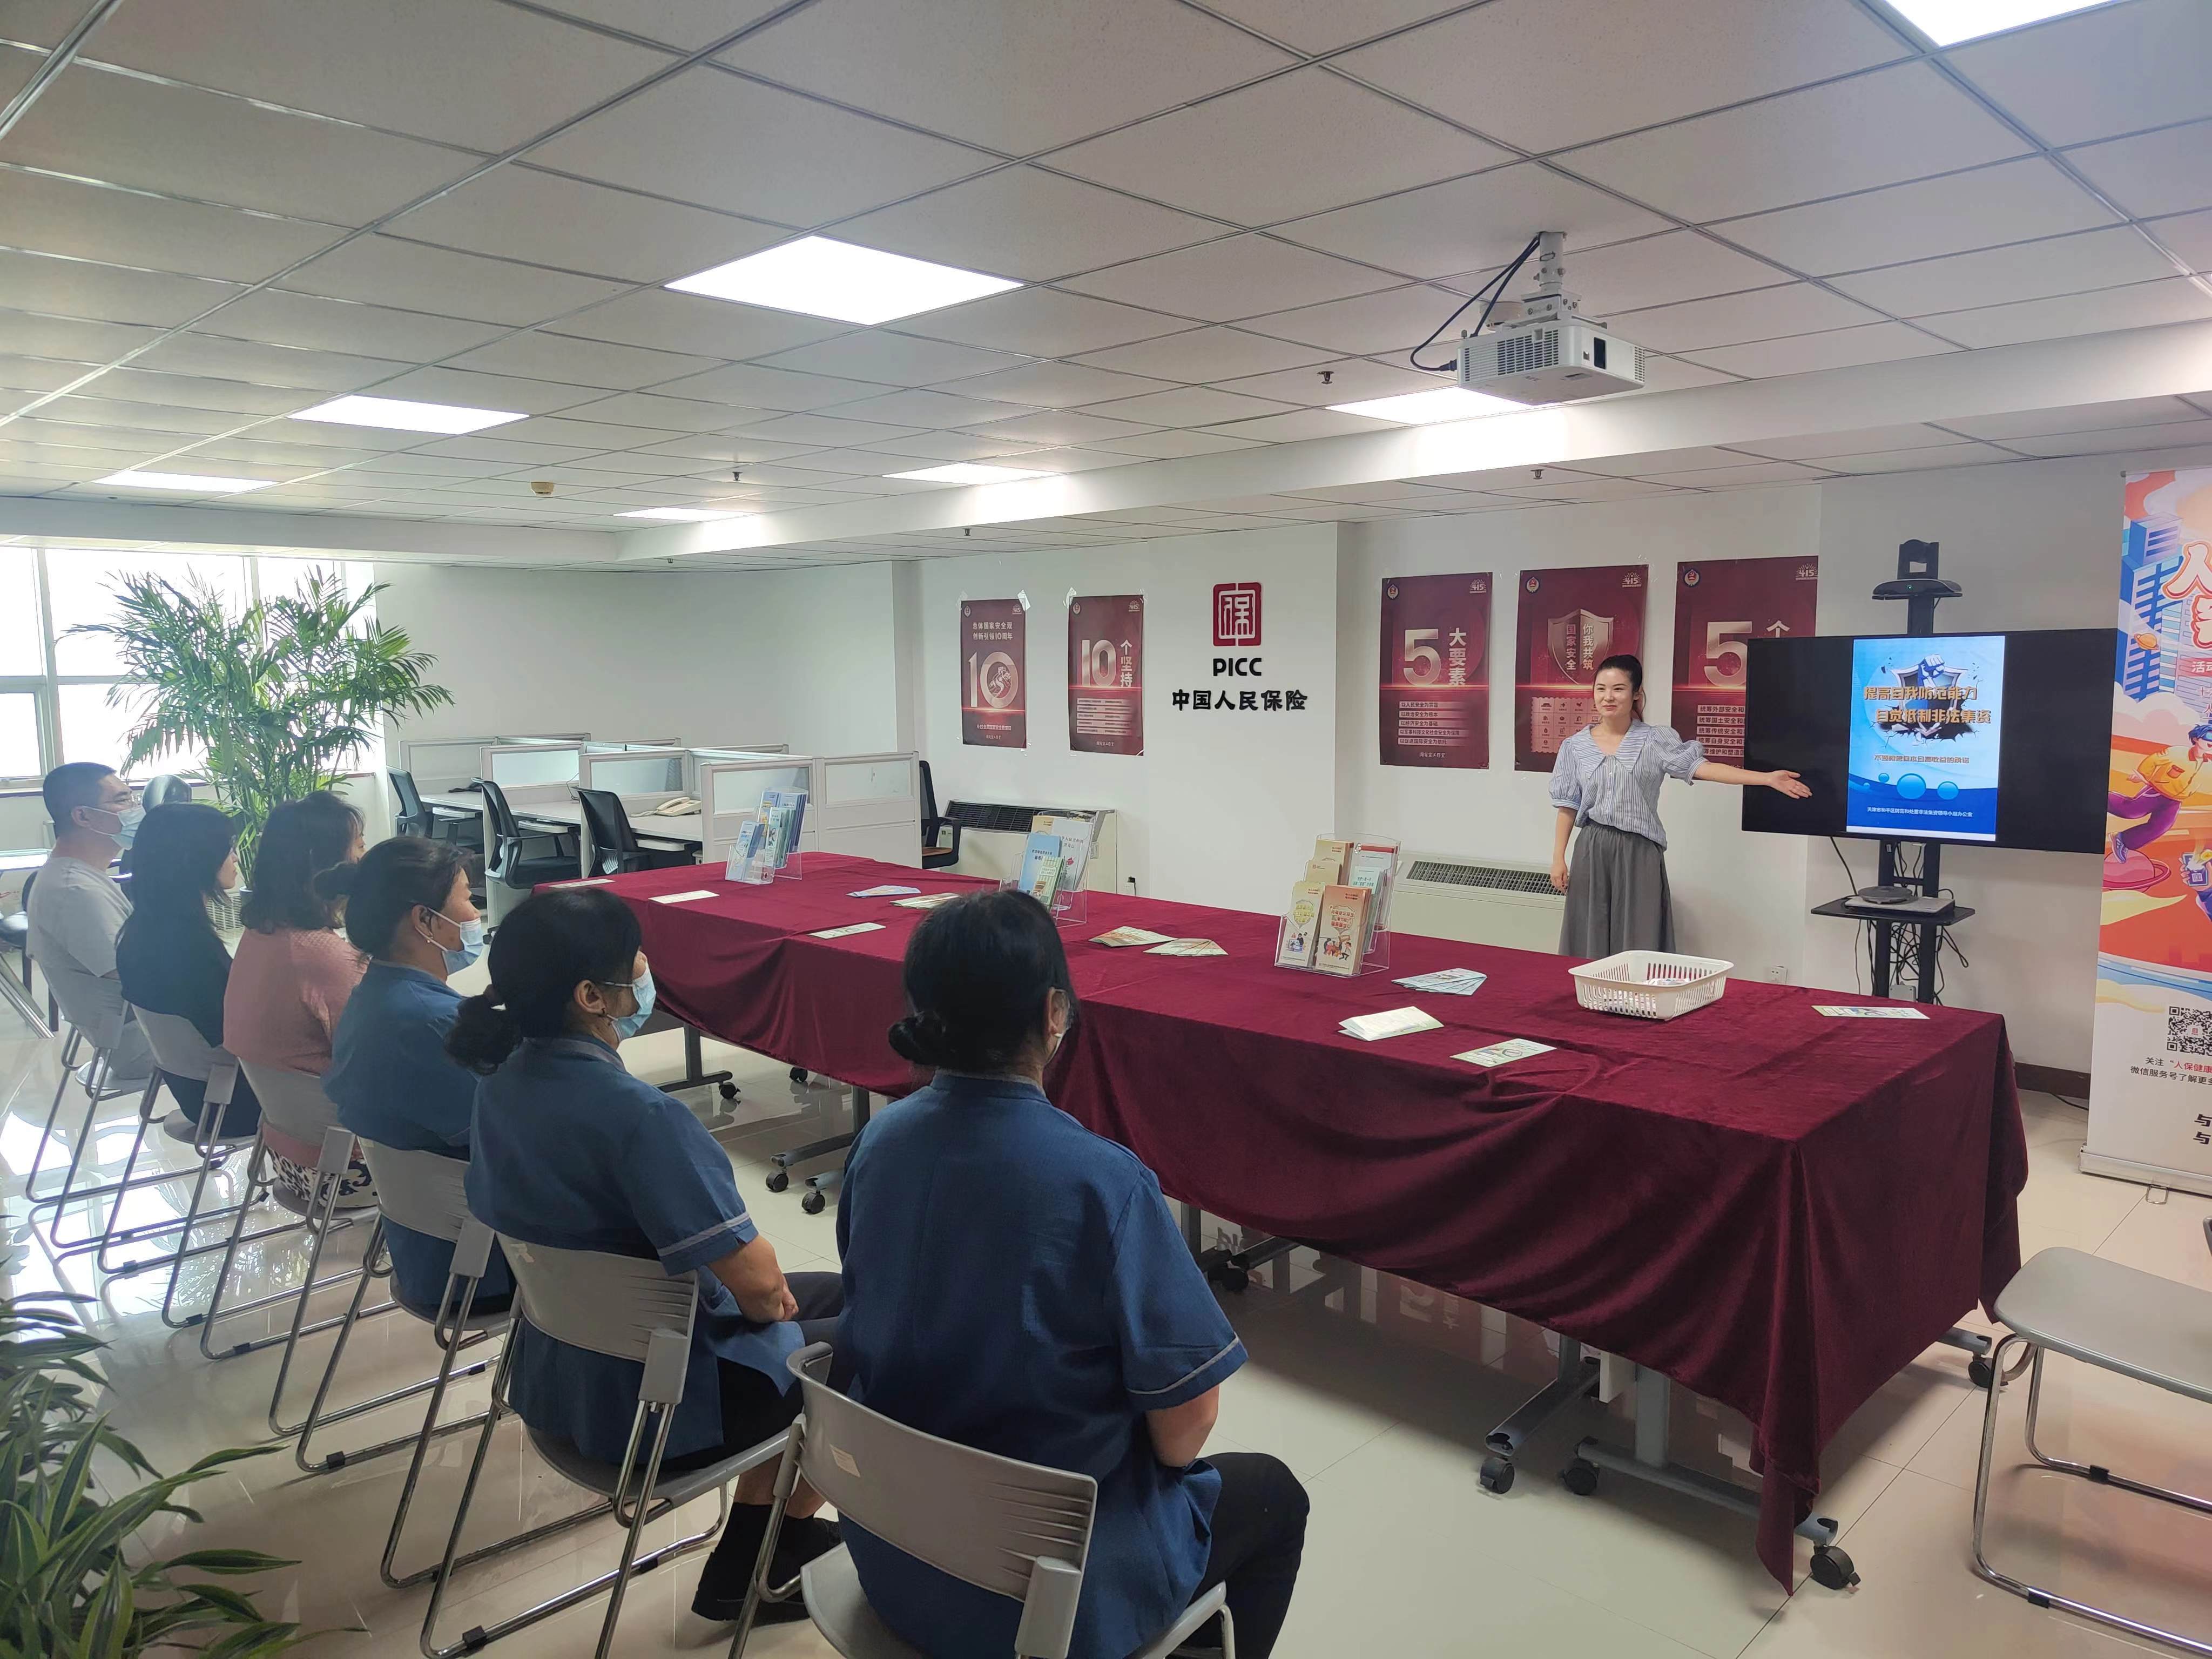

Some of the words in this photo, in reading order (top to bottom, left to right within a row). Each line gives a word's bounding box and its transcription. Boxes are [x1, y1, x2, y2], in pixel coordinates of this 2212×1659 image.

[973, 632, 1013, 640] 创新引领10周年
[1404, 629, 1441, 686] 5
[1449, 628, 1467, 686] 大要素
[1566, 624, 1577, 670] 国家安全
[1582, 624, 1594, 670] 你我共筑
[1704, 621, 1752, 687] 5
[968, 651, 1019, 709] 10
[1082, 639, 1116, 687] 10
[1120, 639, 1133, 687] 个坚持
[1213, 657, 1262, 676] PICC
[1172, 689, 1307, 711] 中国人民保险
[1864, 686, 1978, 700] 提高自我防范能力
[1876, 709, 1992, 724] 自觉抵制非法集资
[2193, 1131, 2211, 1145] 与
[2194, 1114, 2212, 1127] 与
